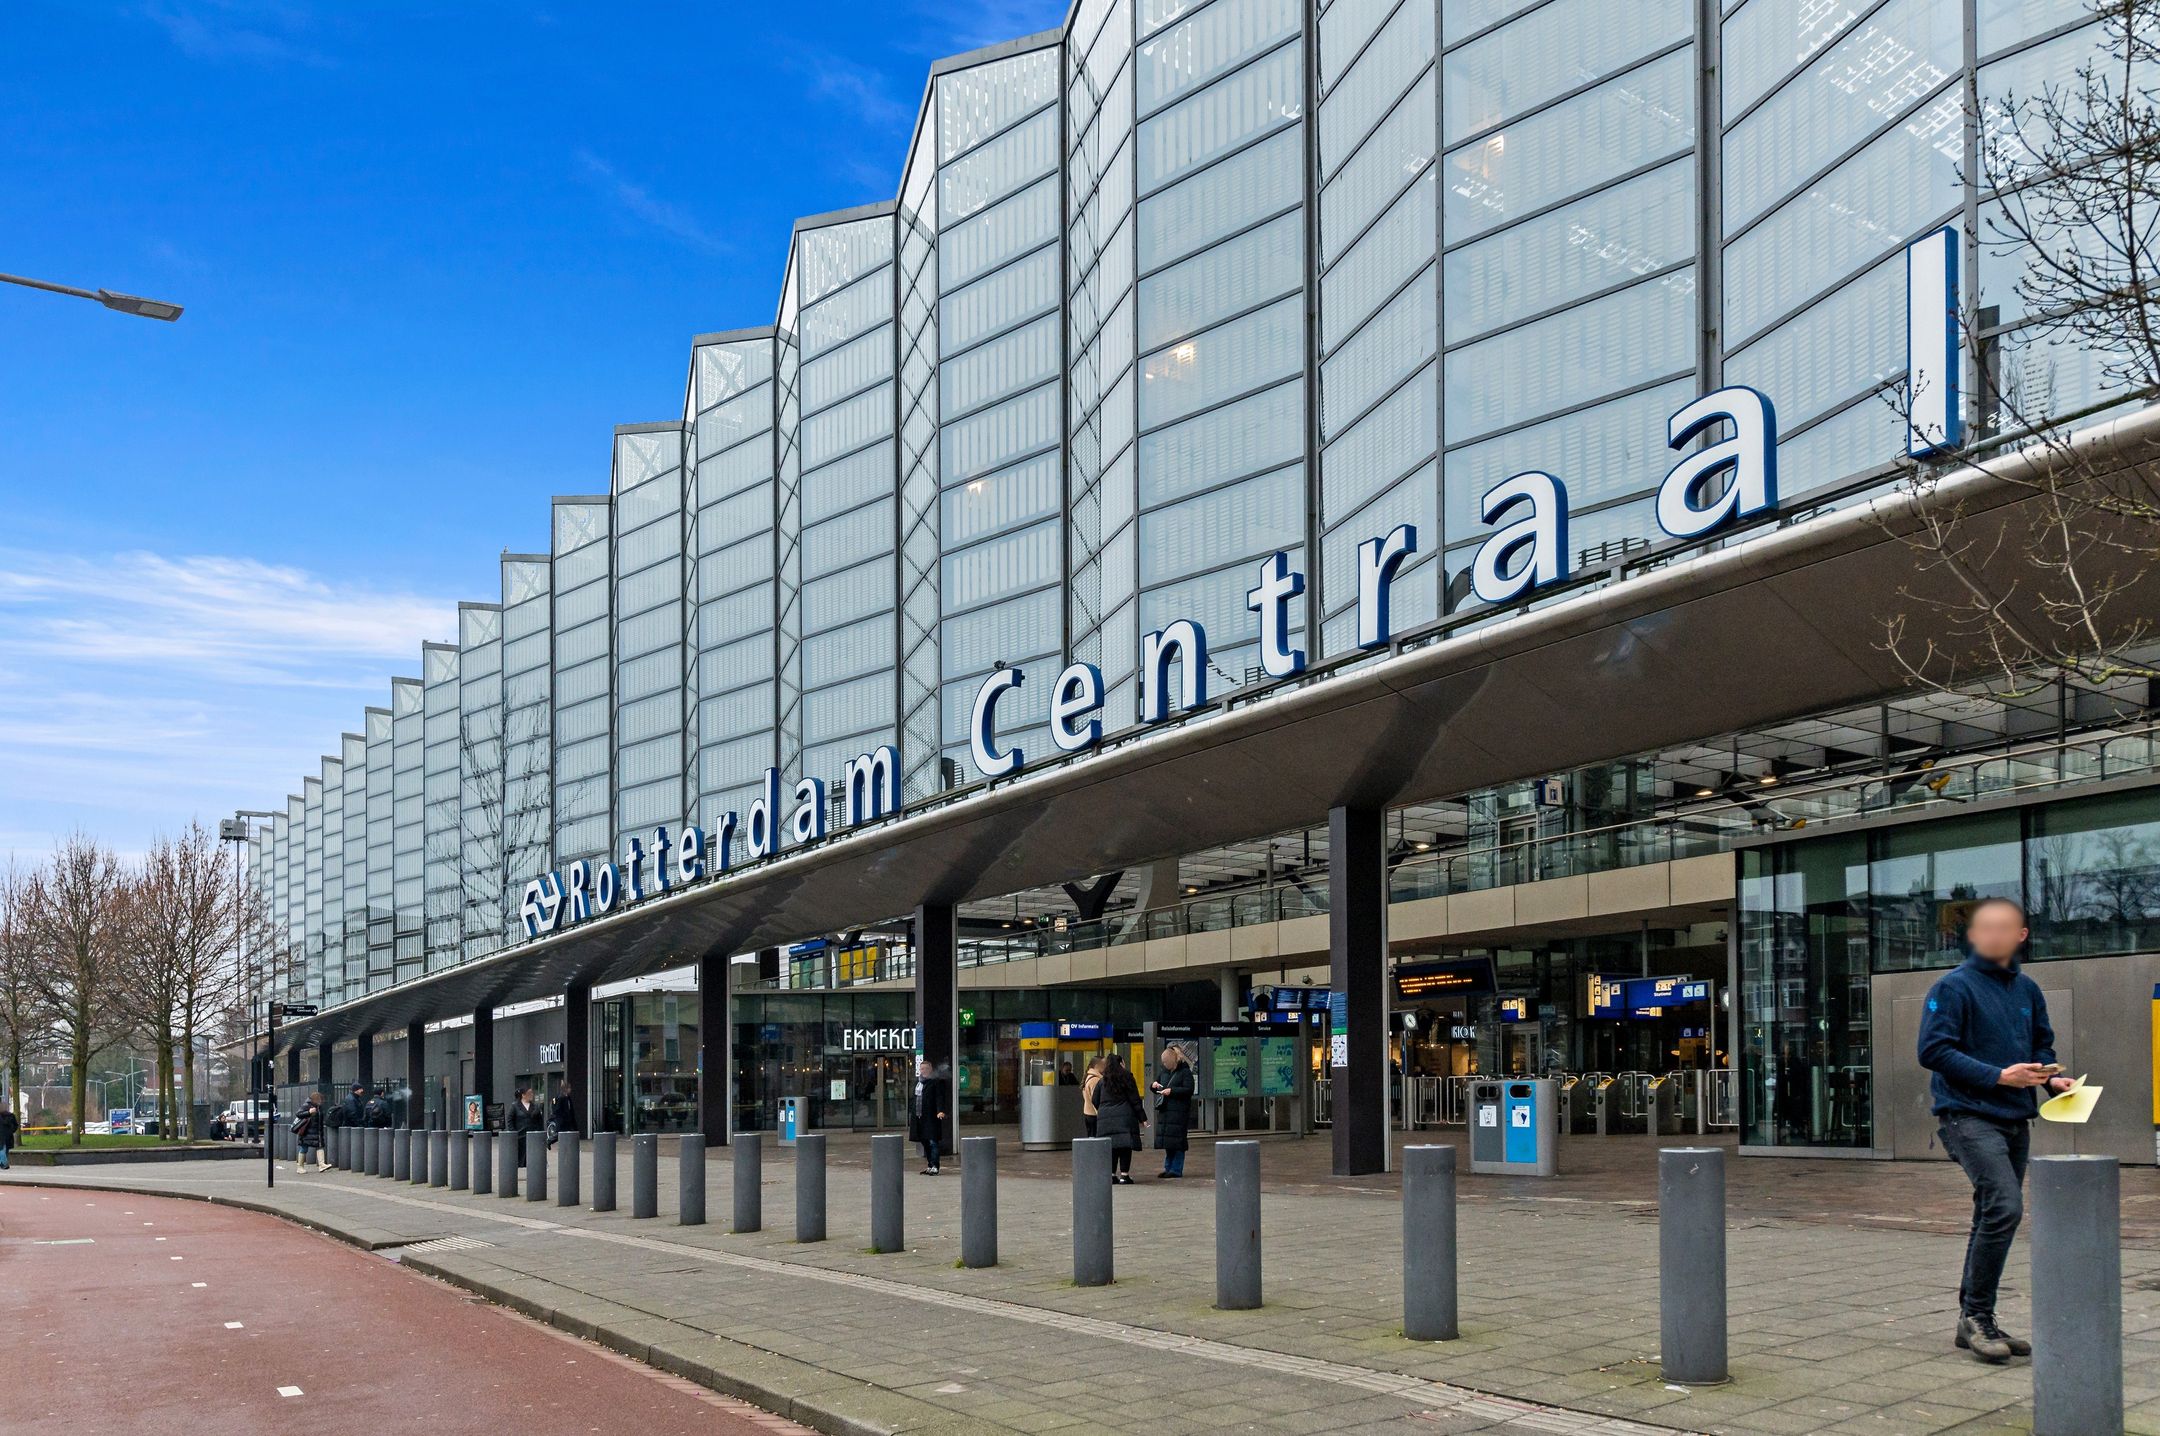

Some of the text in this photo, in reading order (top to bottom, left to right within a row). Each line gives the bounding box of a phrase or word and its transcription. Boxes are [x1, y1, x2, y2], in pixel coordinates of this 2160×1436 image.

[569, 225, 1961, 923] Rotterdam Centraal
[843, 1028, 917, 1051] EKMEKCI
